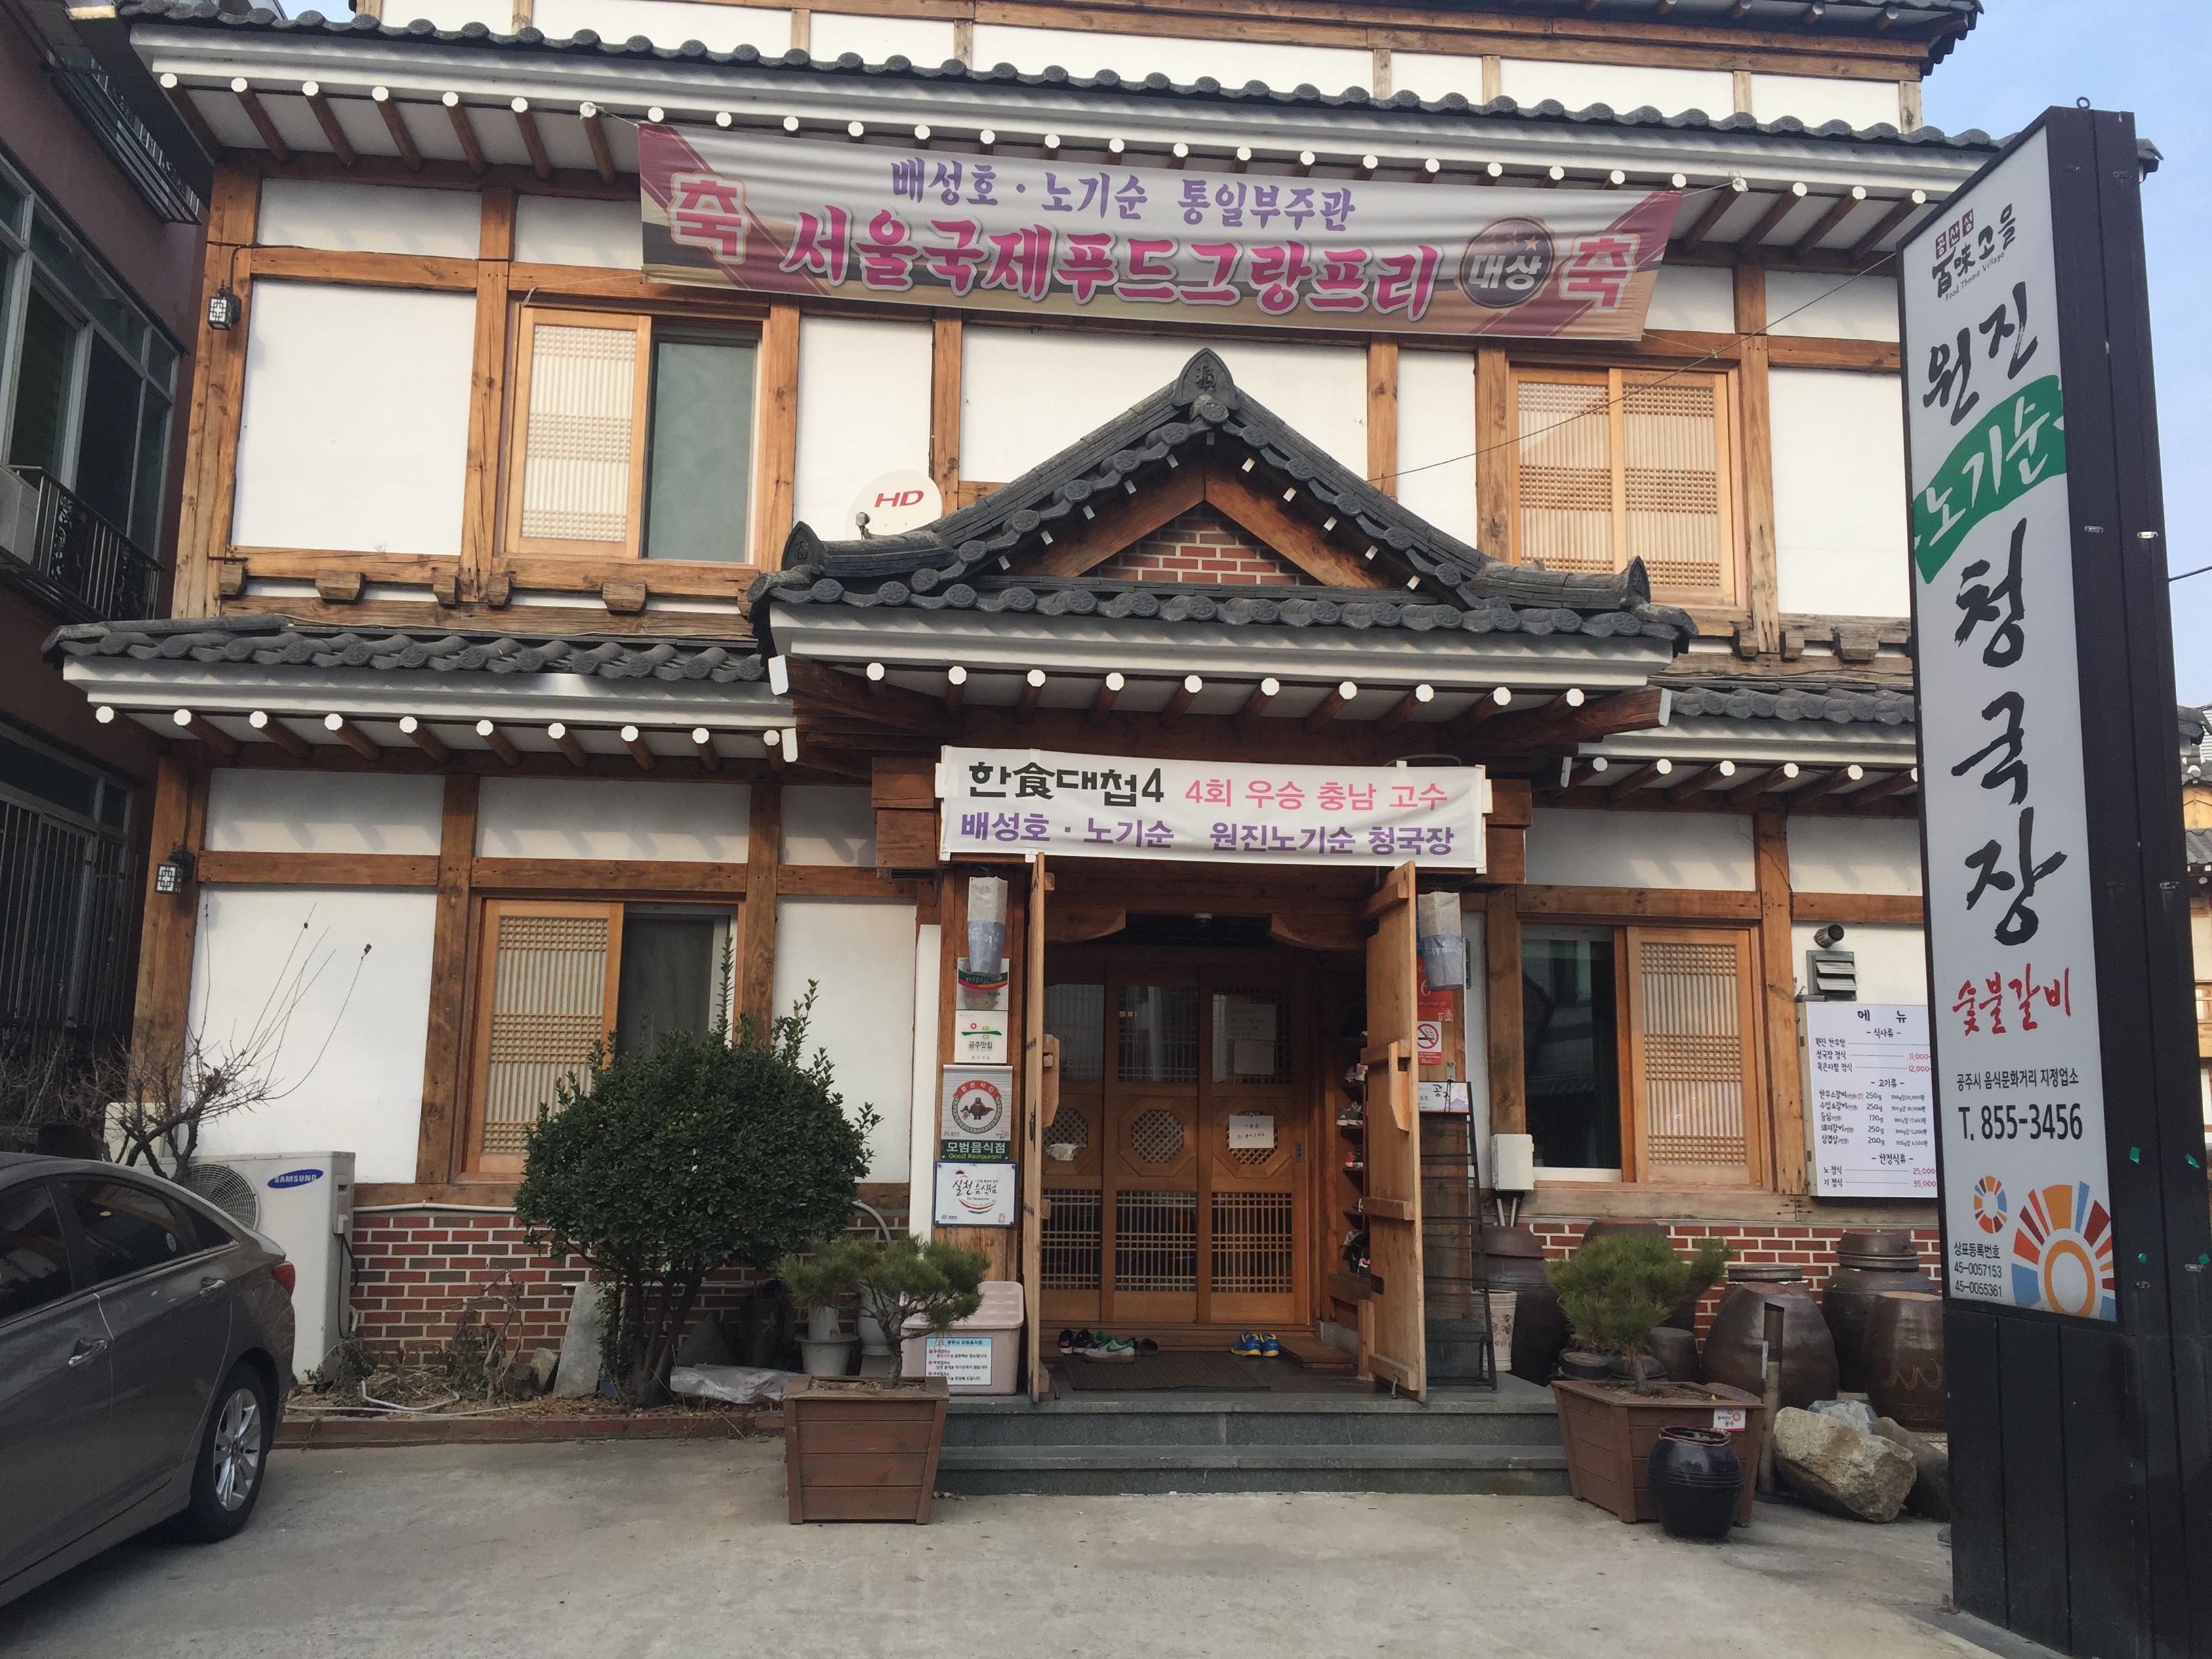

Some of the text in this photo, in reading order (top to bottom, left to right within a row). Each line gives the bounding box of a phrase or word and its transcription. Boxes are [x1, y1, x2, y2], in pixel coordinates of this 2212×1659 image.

[890, 157, 999, 206] 배성호
[1041, 171, 1148, 220] 노기순
[1178, 178, 1356, 231] 통일부주관
[678, 178, 745, 260] 축
[1936, 208, 1975, 260] 공산성
[783, 204, 1443, 319] 서울국제푸드그랑프리
[1468, 253, 1542, 290] 대상
[1569, 236, 1633, 309] 축
[1945, 251, 2005, 301] Food Theme Village
[1923, 281, 2039, 426] 원진
[1926, 396, 2050, 546] 노기순
[874, 490, 924, 508] HD
[1950, 518, 2068, 946] 청국장
[968, 761, 1448, 812] 한食대첩4 4회 우승 충남 고수
[961, 812, 1051, 842] 배성호
[1085, 816, 1174, 849] 노기순
[1210, 821, 1355, 856] 원진노기순
[1368, 825, 1454, 856] 청국장
[1952, 962, 2072, 1037] 숯불갈비
[1816, 1050, 1833, 1060] 청국장
[1835, 1050, 1846, 1061] 정식
[1841, 1063, 1853, 1073] 정식
[1879, 1079, 1897, 1088] 고기류
[1957, 1067, 2079, 1092] 공주시 음식문화거리 지정업소
[1866, 1092, 1882, 1101] 250g
[1866, 1103, 1883, 1112] 250g
[1869, 1115, 1883, 1123] 170g
[1958, 1103, 2083, 1141] T. 855-3456
[1868, 1126, 1884, 1135] 250g
[946, 1141, 1006, 1153] 모범음식점
[1868, 1137, 1885, 1146] 200g
[1879, 1153, 1906, 1164] 한정식류
[274, 1174, 317, 1184] SAMSUNG
[1830, 1166, 1843, 1175] 정식
[1831, 1178, 1843, 1188] 정식
[1954, 1242, 2001, 1259] 상표등록번호
[1954, 1261, 2003, 1279] 45-0057153
[1954, 1281, 2003, 1298] 45-0055361
